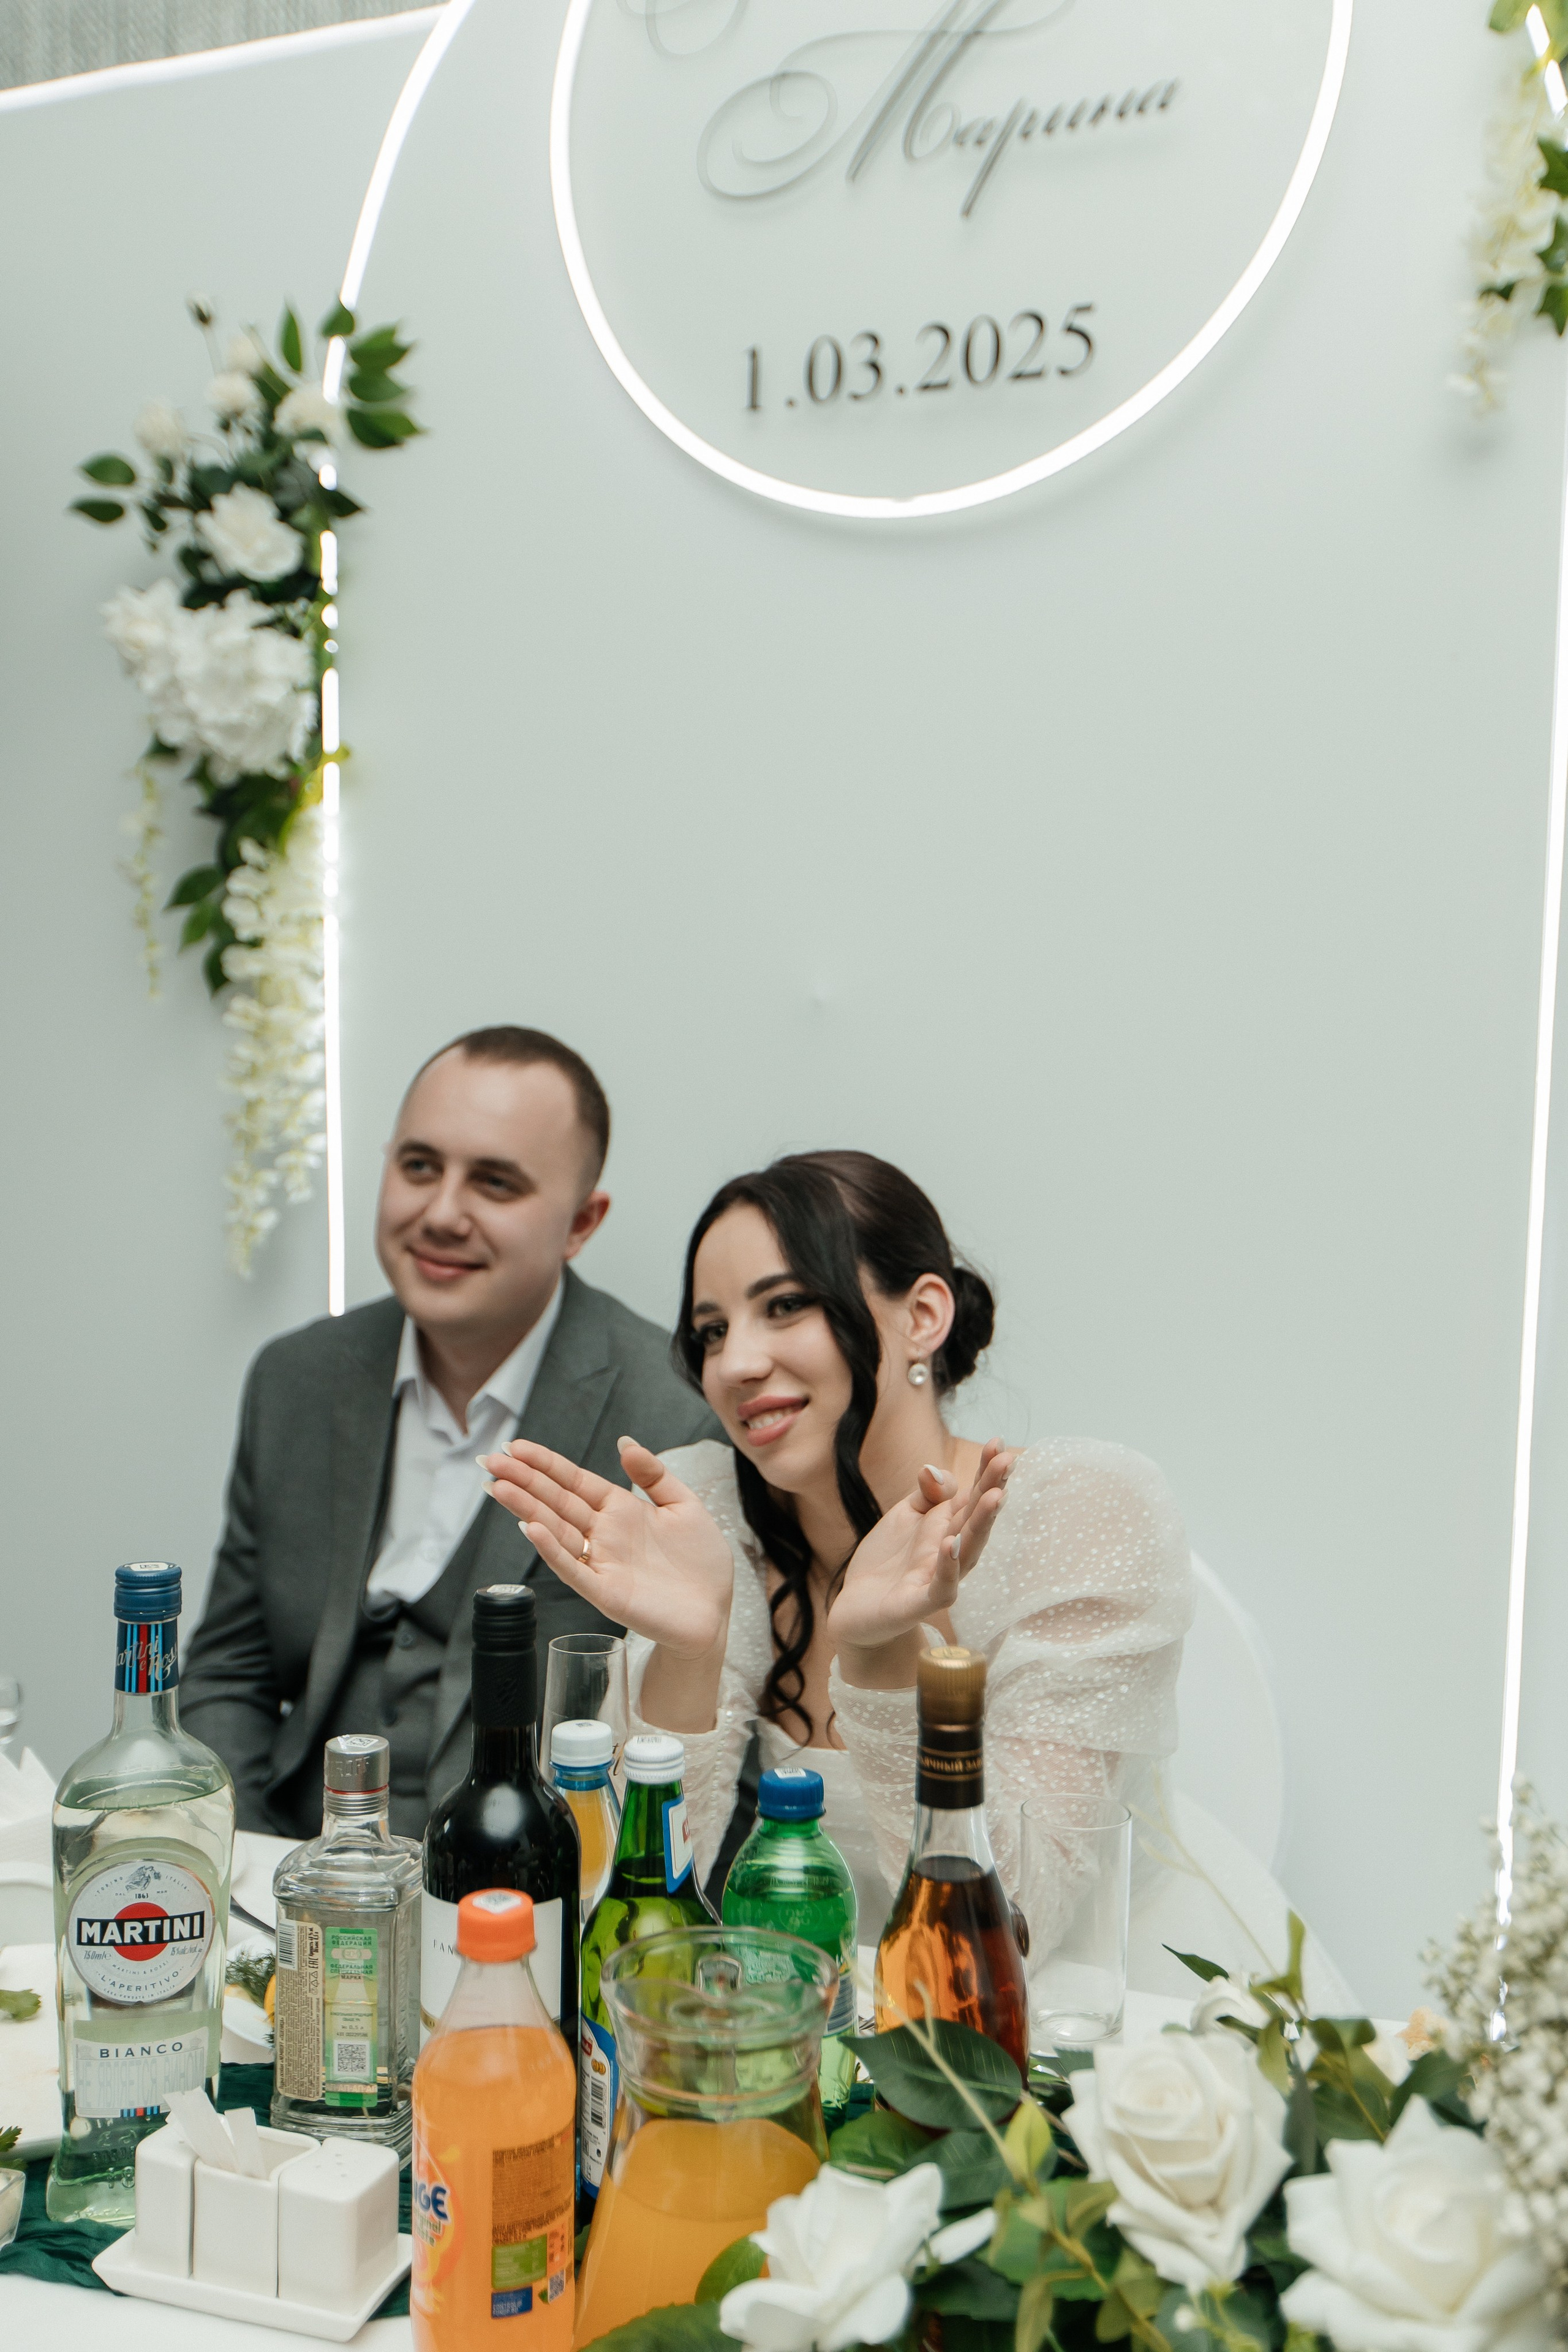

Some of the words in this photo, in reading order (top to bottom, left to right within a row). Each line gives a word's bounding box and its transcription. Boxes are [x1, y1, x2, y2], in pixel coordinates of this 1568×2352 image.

[696, 0, 1182, 219] Марина
[742, 303, 1097, 412] 1.03.2025
[116, 1635, 159, 1668] artini
[920, 1756, 963, 1773] ЯЧНЫЙ
[96, 1876, 123, 1894] TORINO
[165, 1875, 187, 1890] ITALIA
[81, 1914, 200, 1944] MARTINI
[100, 1970, 179, 1992] L'APERITIVO
[100, 2041, 183, 2058] BIANCO
